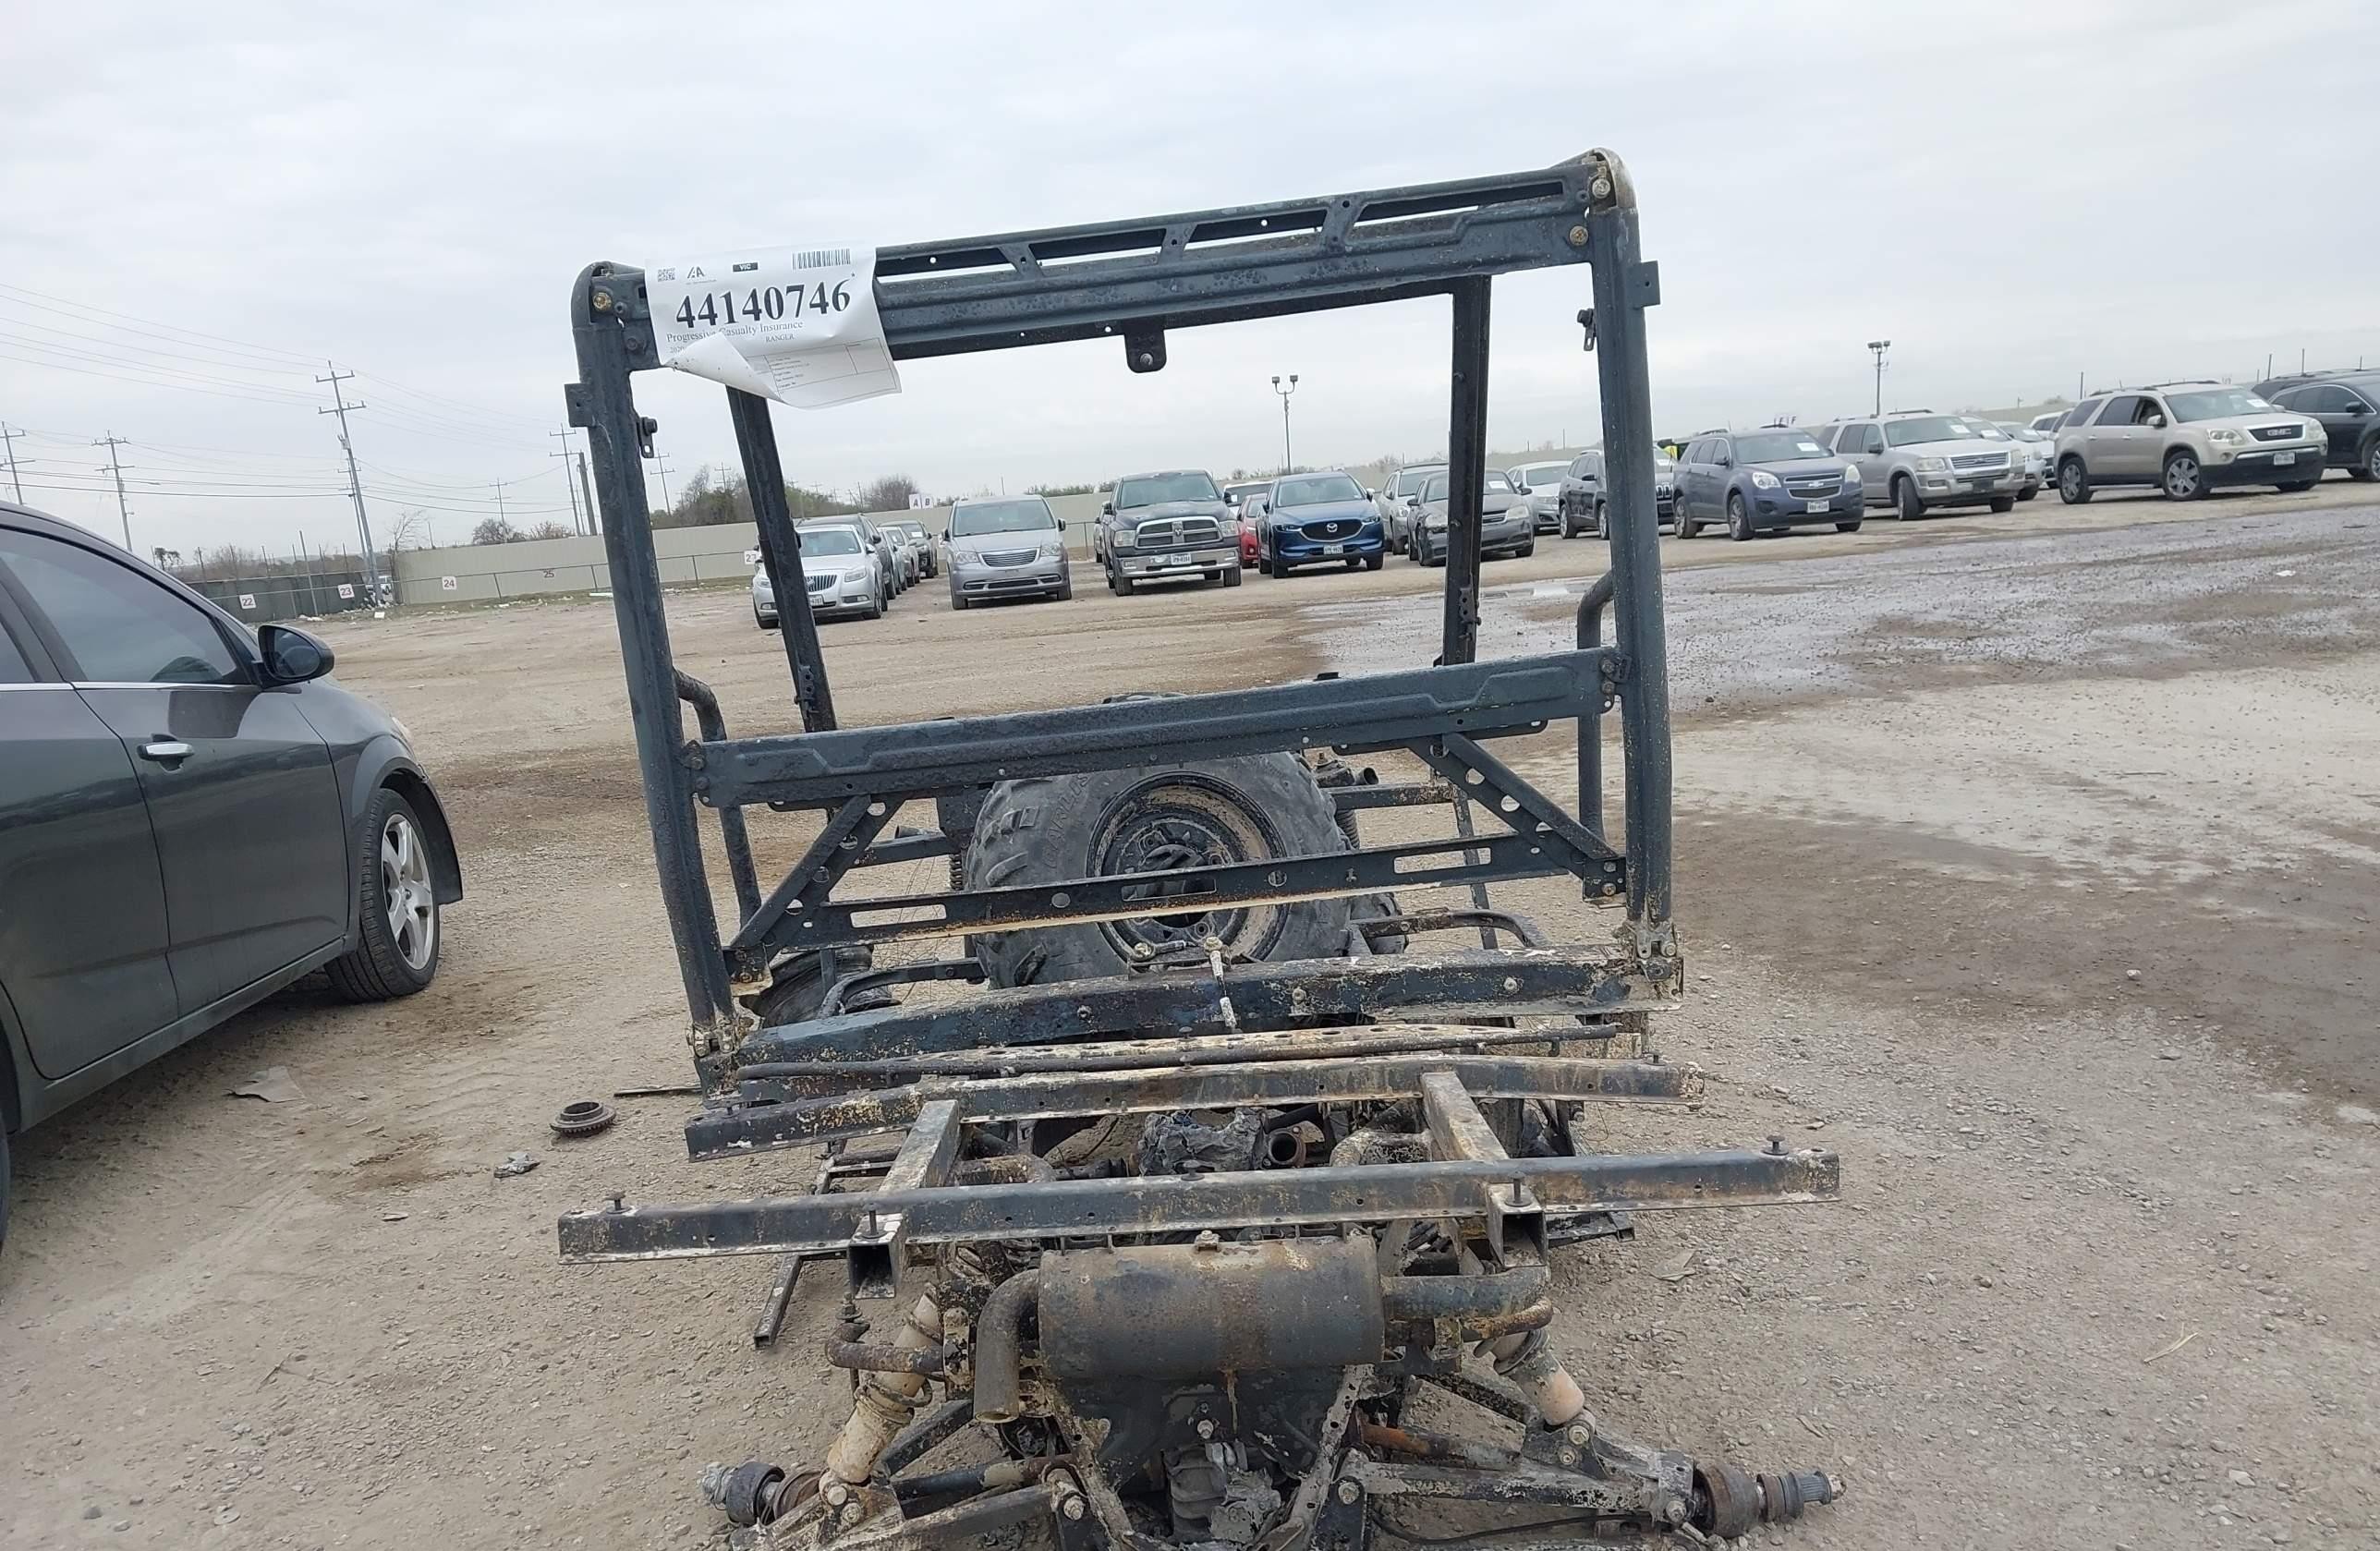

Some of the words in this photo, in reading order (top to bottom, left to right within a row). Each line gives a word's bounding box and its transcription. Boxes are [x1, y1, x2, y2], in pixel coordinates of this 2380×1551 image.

[676, 278, 851, 329] 44140746
[718, 324, 757, 336] Casualty
[759, 321, 804, 333] Insurance
[443, 579, 455, 588] 24
[339, 588, 352, 597] 23
[241, 597, 254, 607] 22
